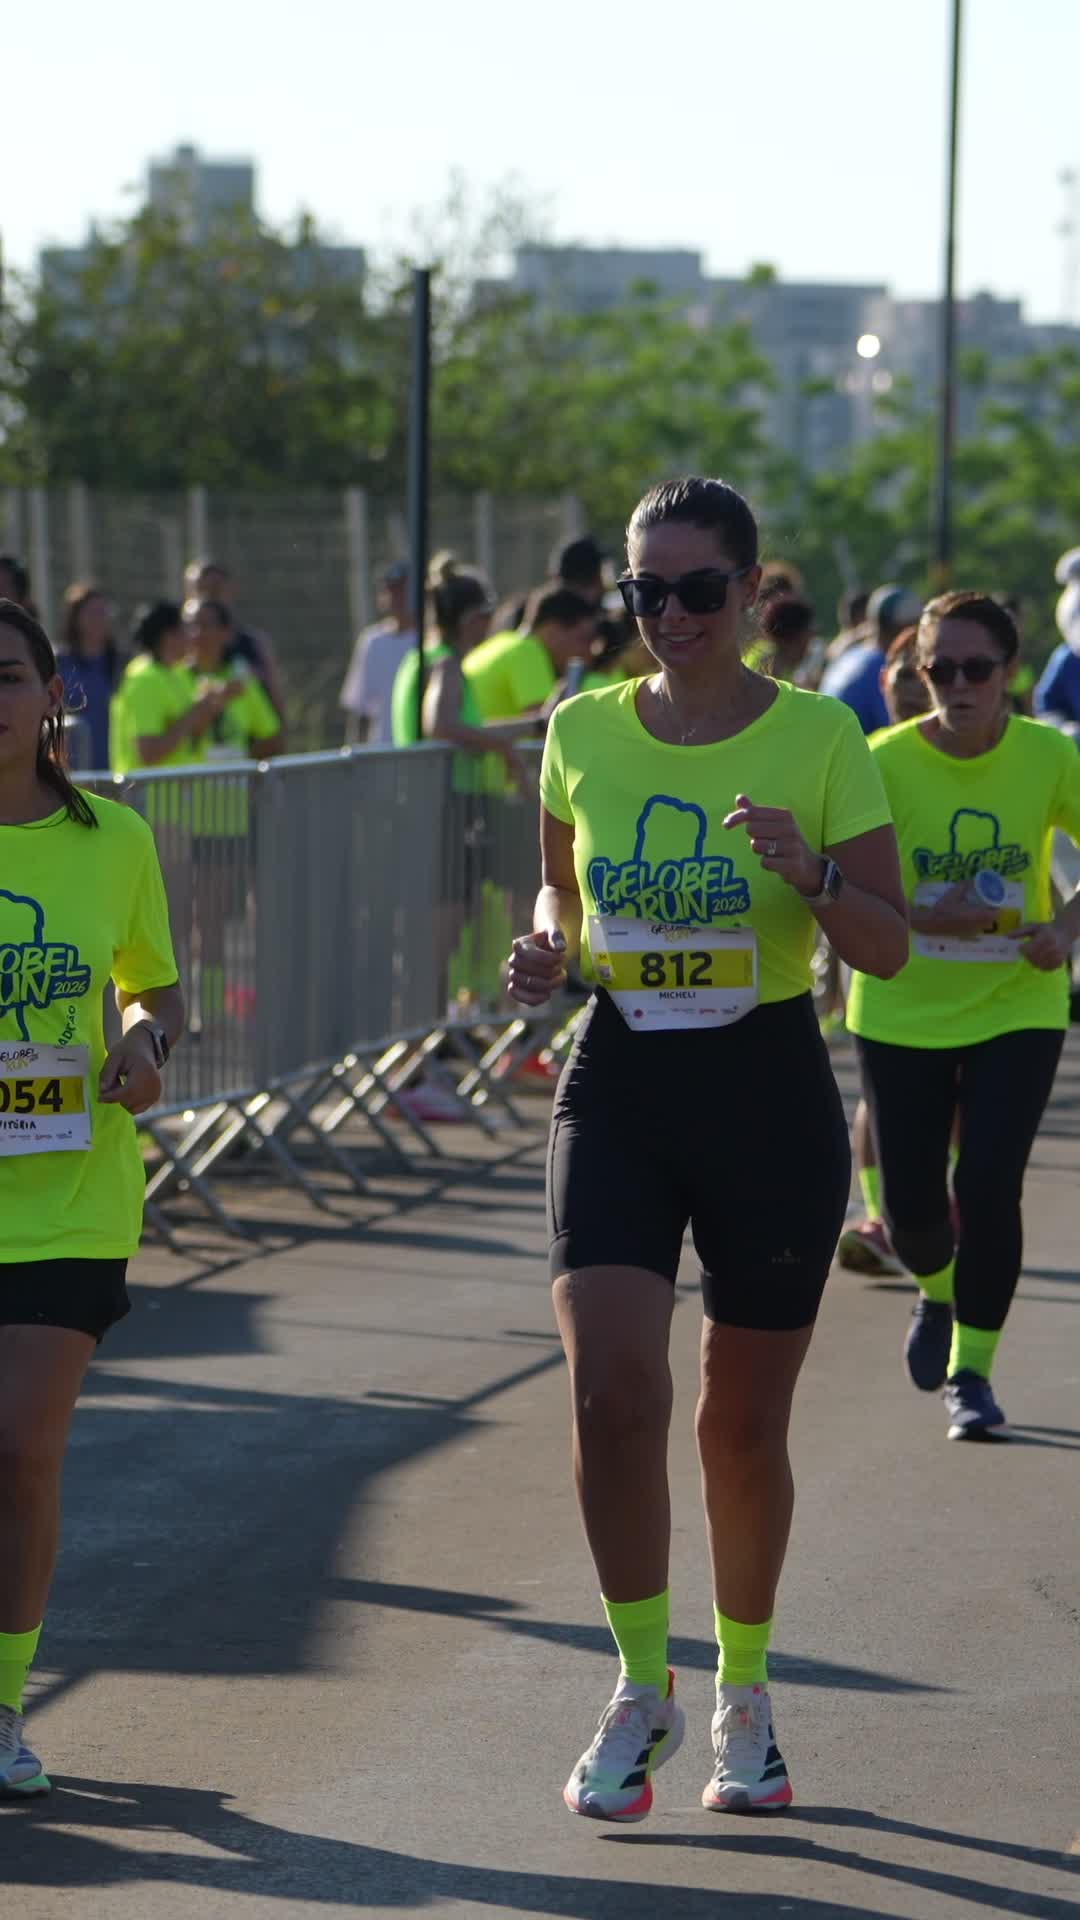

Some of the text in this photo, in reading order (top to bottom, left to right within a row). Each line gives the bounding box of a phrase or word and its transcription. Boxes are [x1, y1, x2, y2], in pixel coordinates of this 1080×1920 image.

[602, 860, 743, 905] GELOBEL
[636, 885, 747, 922] RUN 2026
[0, 946, 87, 977] OBEL
[640, 951, 713, 988] 812
[0, 972, 88, 1006] UN 2026
[659, 991, 697, 1000] MICHELI
[0, 1046, 36, 1063] ELOBEL
[0, 1079, 64, 1114] 054
